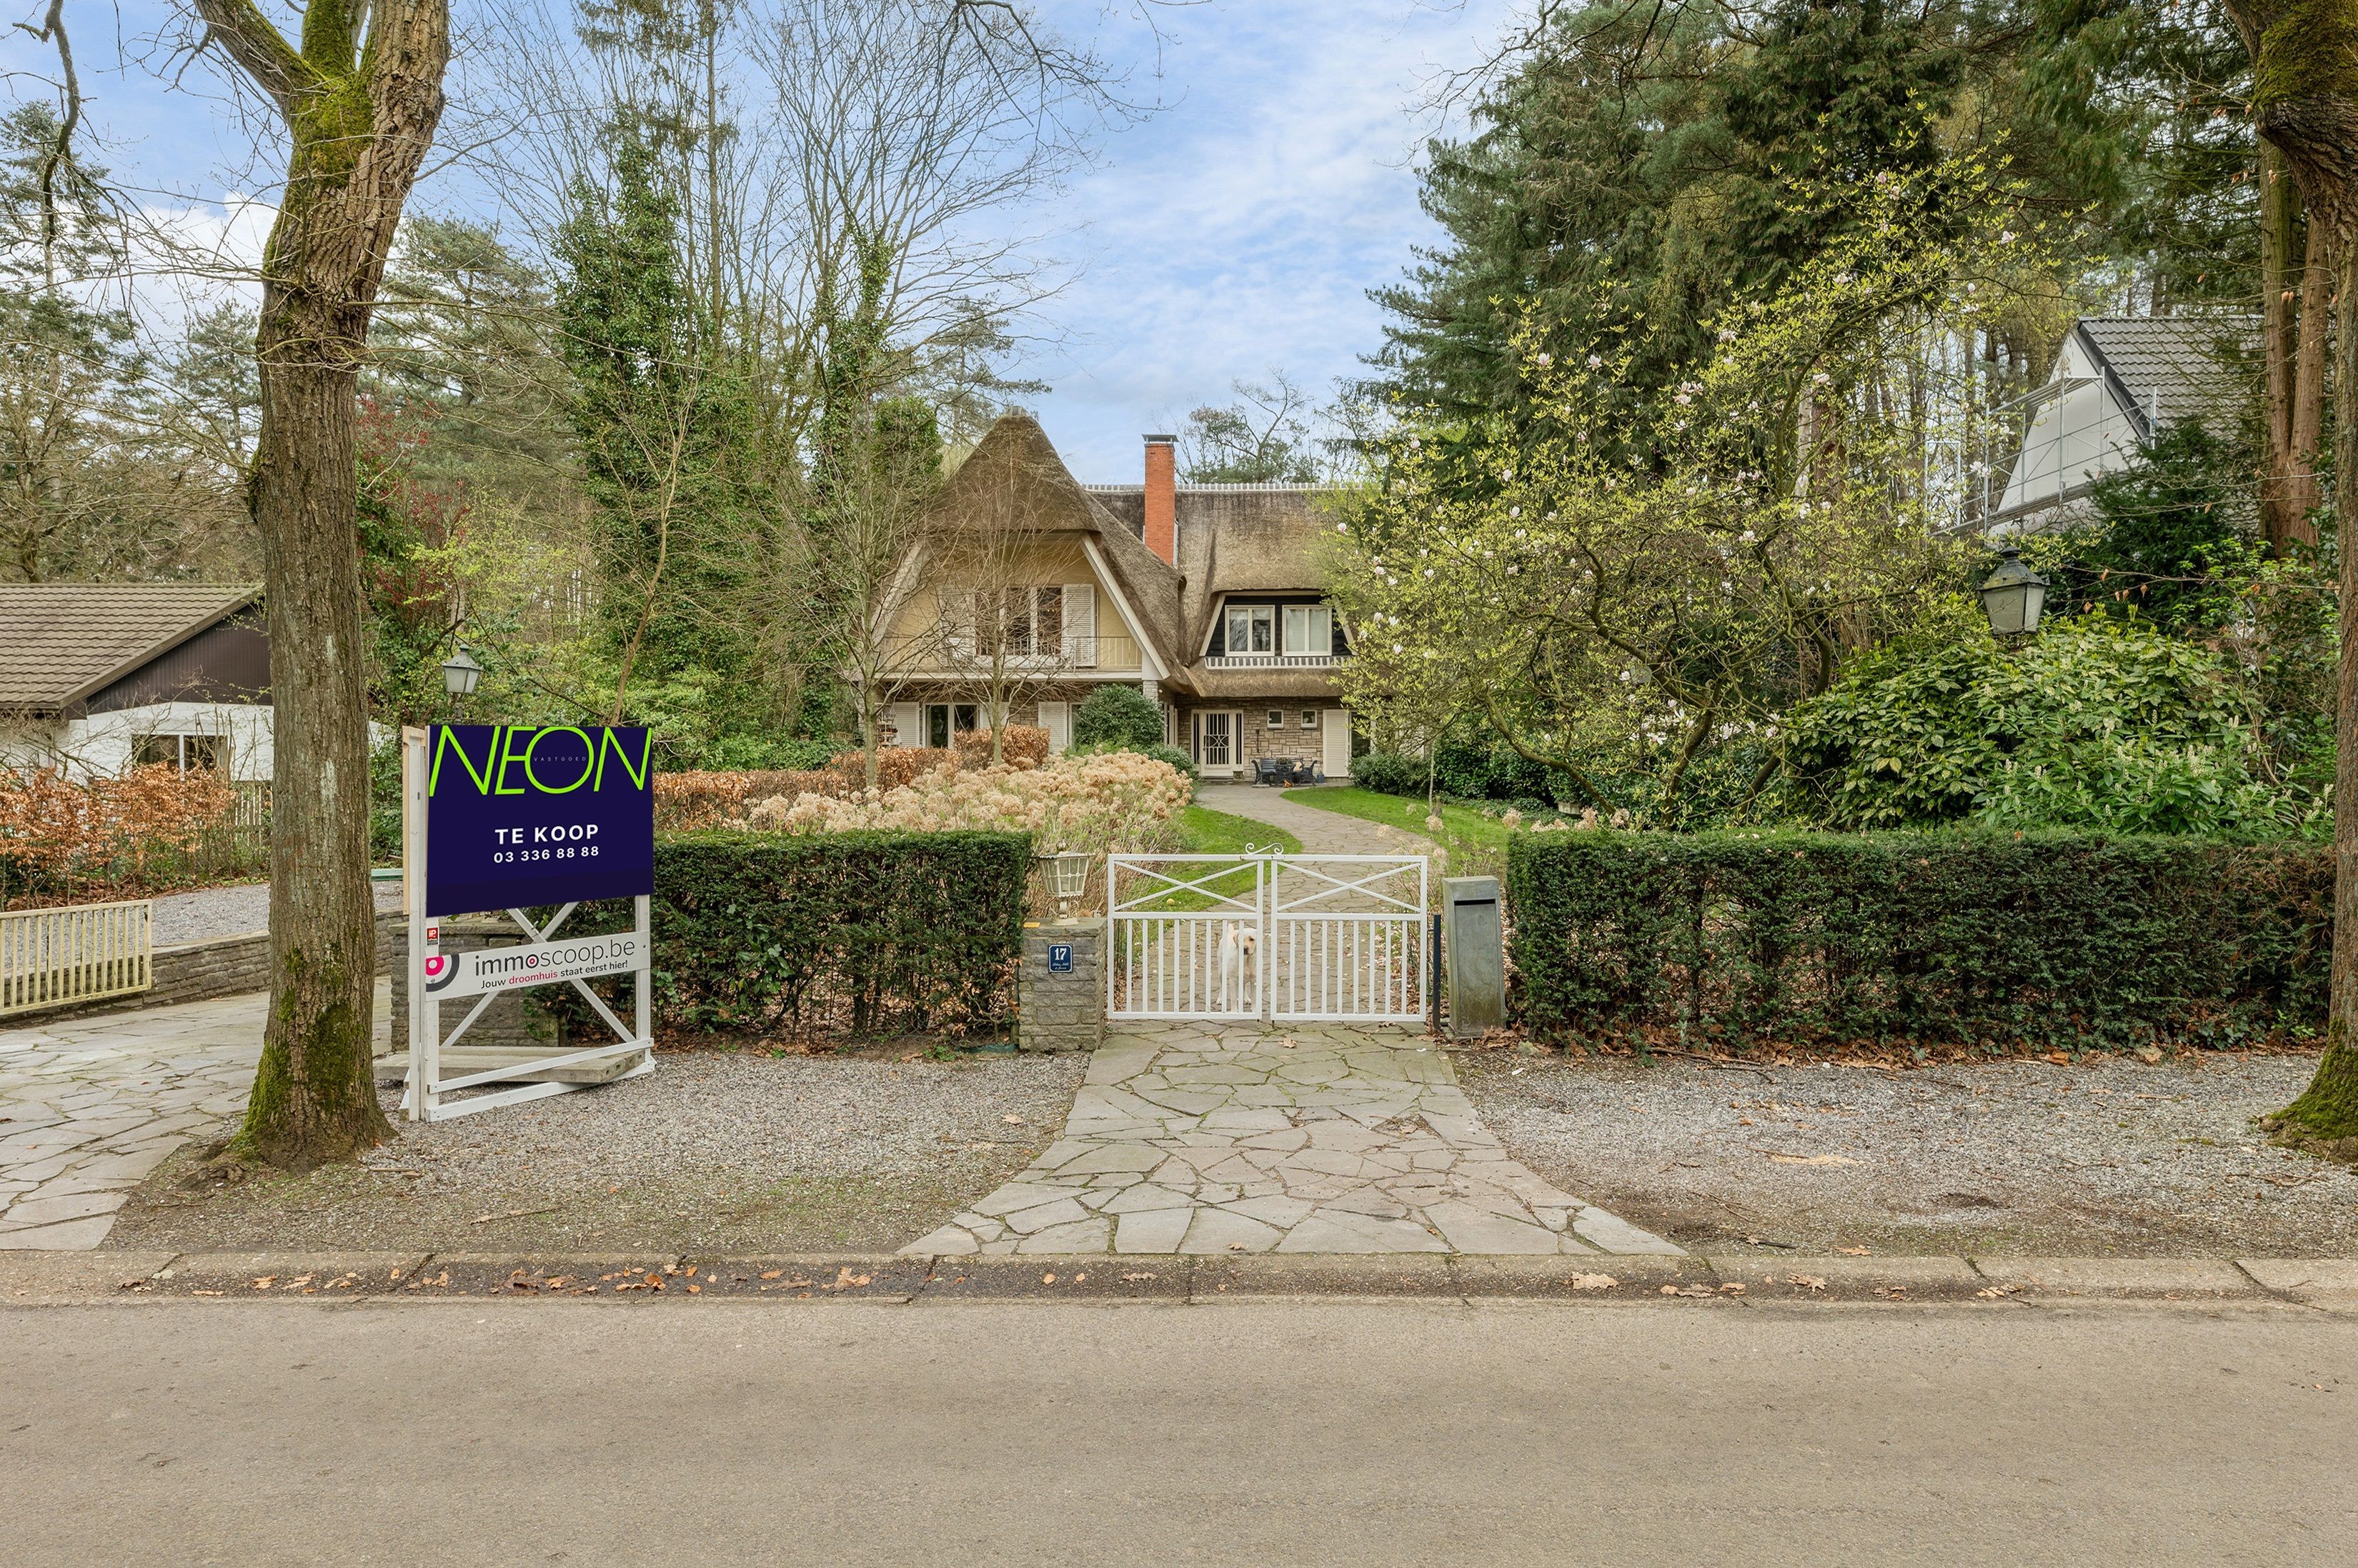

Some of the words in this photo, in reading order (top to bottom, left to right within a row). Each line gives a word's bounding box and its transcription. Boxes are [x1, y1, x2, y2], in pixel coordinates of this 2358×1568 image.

[429, 725, 652, 797] NEON
[494, 828, 524, 844] TE
[534, 824, 598, 843] KOOP
[494, 852, 514, 863] 03
[520, 849, 550, 862] 336
[556, 848, 574, 859] 88
[581, 846, 599, 857] 88
[475, 939, 635, 976] immoscoop.be
[1055, 948, 1067, 960] 17
[481, 979, 506, 989] Jouw
[509, 970, 558, 984] droomhuis
[560, 967, 583, 977] staat
[585, 963, 607, 974] eerst
[610, 959, 628, 969] hier!
